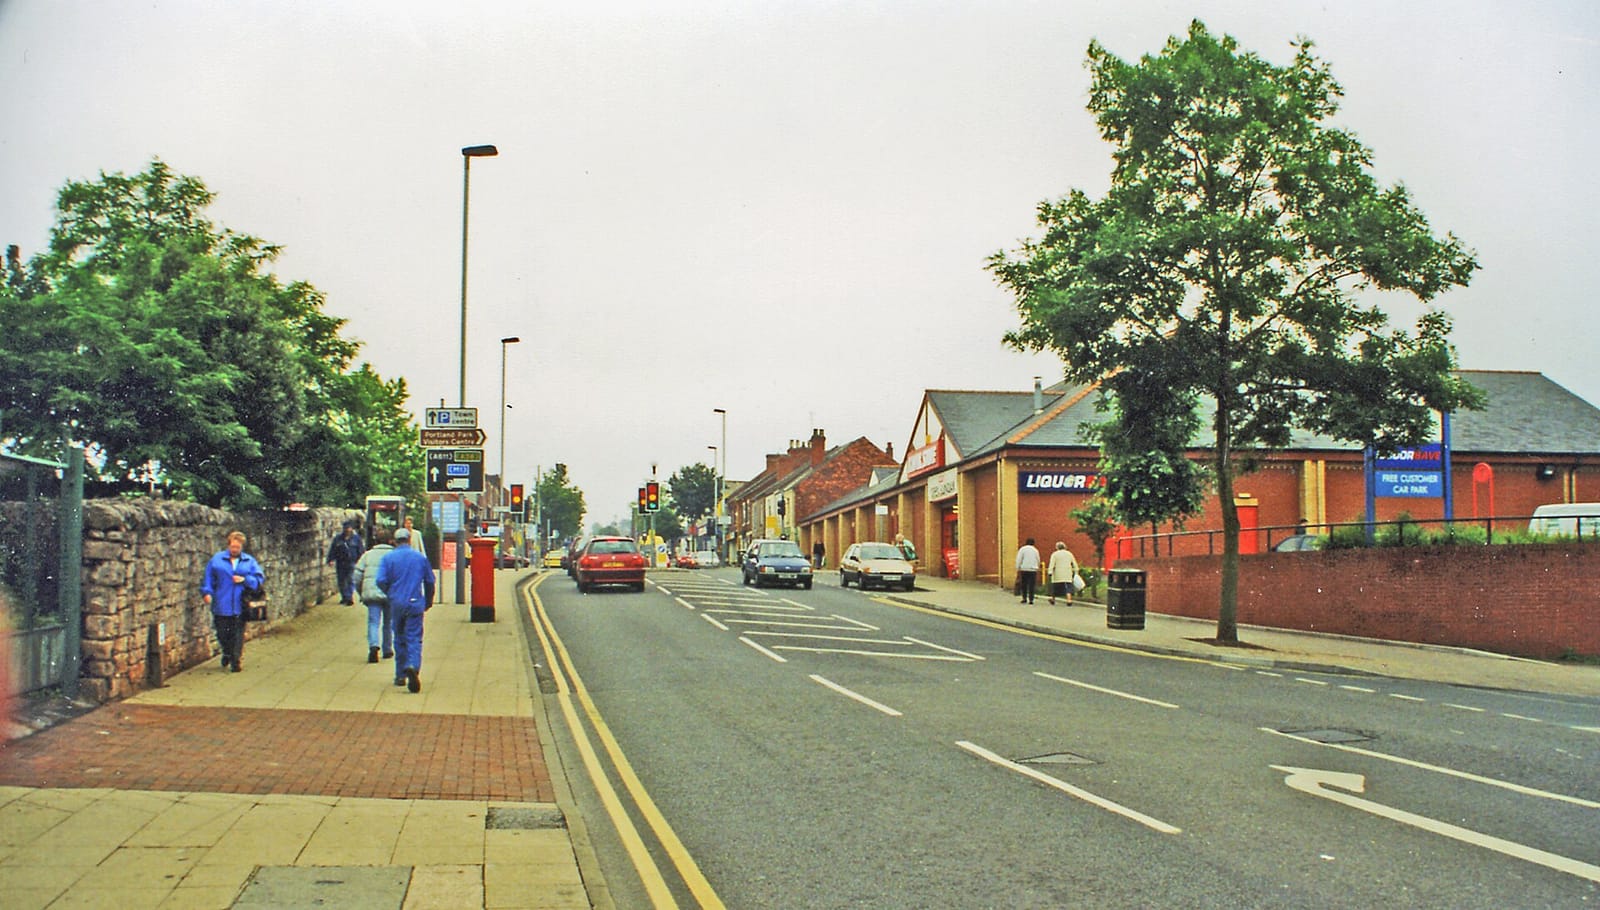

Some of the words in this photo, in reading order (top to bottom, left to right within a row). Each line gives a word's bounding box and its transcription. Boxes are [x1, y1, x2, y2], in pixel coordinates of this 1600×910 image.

[1382, 474, 1398, 482] FREE
[1400, 474, 1438, 483] CUSTOMER
[1392, 485, 1408, 493] CAR
[1410, 485, 1429, 494] PARK
